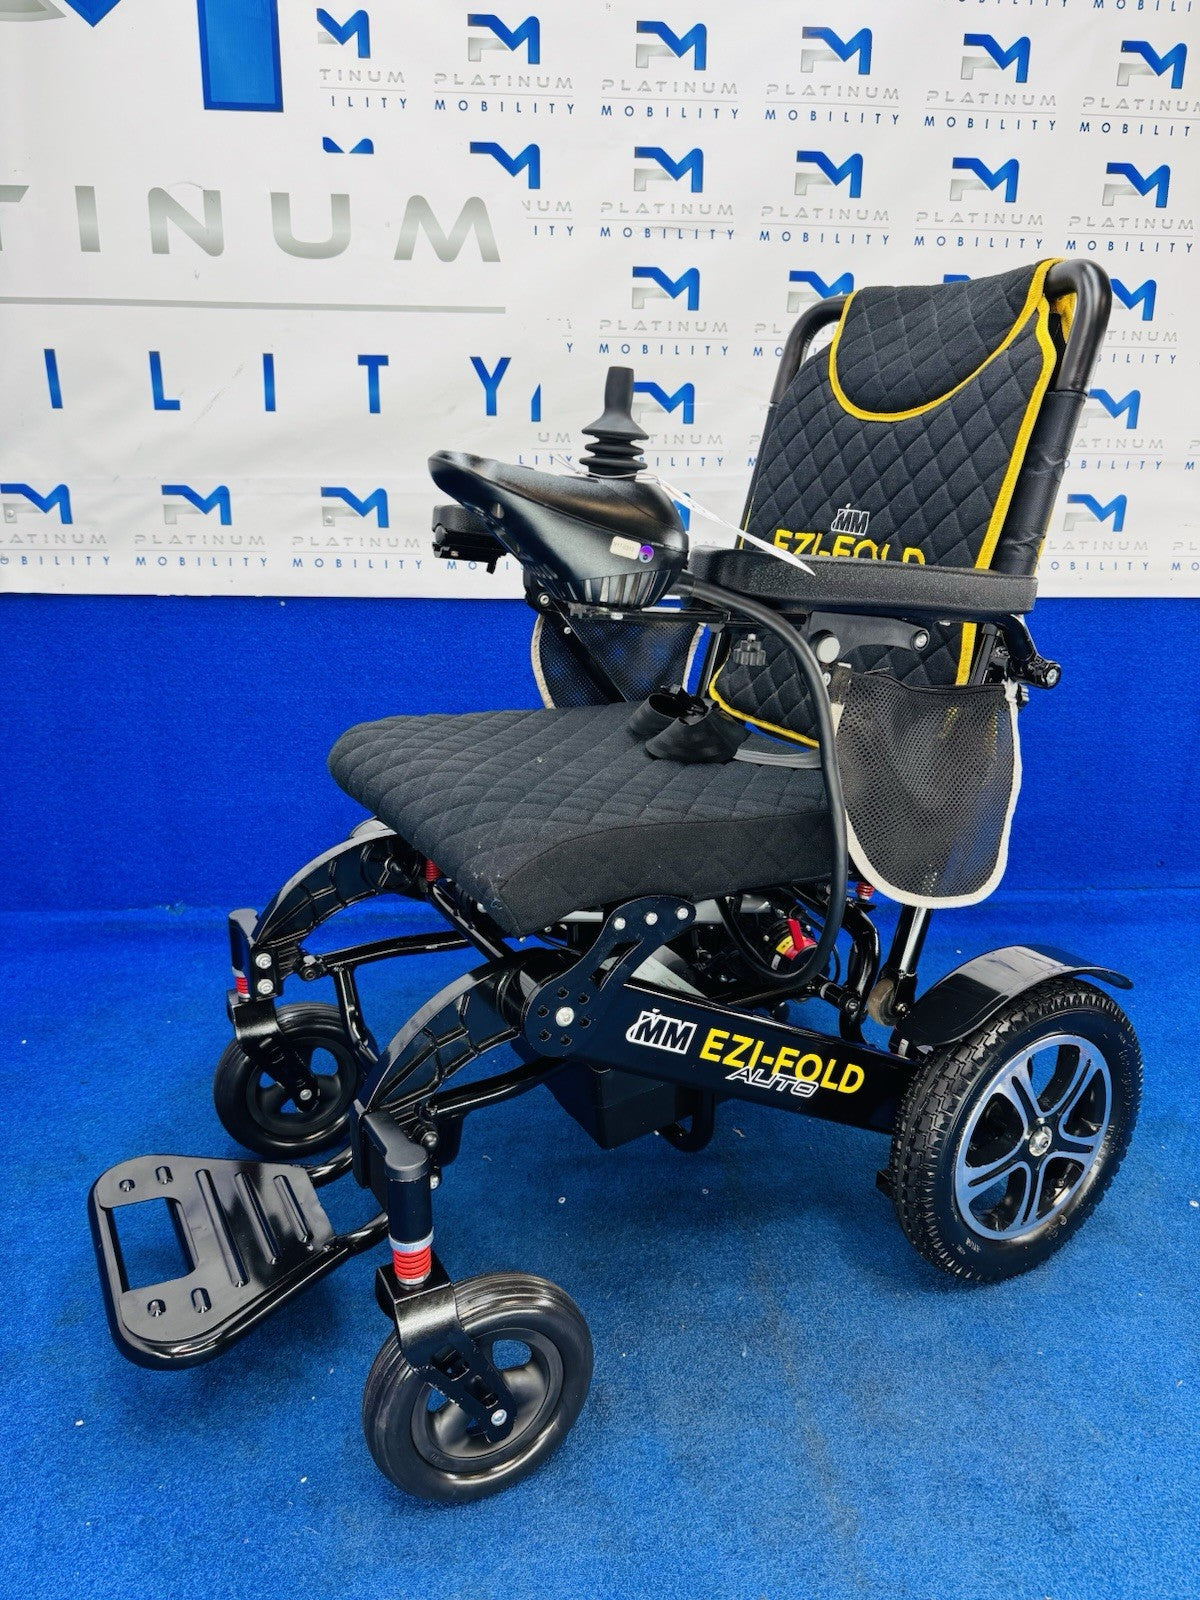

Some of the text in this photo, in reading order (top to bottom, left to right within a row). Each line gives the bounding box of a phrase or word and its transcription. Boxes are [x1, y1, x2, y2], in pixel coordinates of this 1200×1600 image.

[1093, 0, 1193, 13] MOBILI
[434, 73, 574, 90] PLATINUM
[601, 79, 739, 95] PLATINUM
[766, 84, 900, 100] PLATINUM
[926, 90, 1057, 106] PLATINUM
[434, 100, 575, 115] MOBILITY
[601, 105, 739, 119] MOBILITY
[765, 110, 900, 125] MOBILITY
[924, 116, 1056, 131] MOBILITY
[1080, 122, 1191, 137] MOBILIT
[600, 201, 734, 216] PLATINUM
[760, 206, 890, 221] PLATINUM
[916, 211, 1044, 226] PLATINUM
[1069, 216, 1195, 230] PLATINUM
[600, 226, 735, 240] MOBILITY
[759, 230, 890, 245] MOBILITY
[914, 235, 1043, 249] MOBILITY
[1066, 240, 1194, 253] MOBILITY
[599, 320, 728, 333] PLATINUM
[1106, 331, 1178, 342] TINUM
[598, 343, 729, 356] MOBILITY
[1112, 353, 1177, 364] ILITY
[649, 434, 723, 444] TINUM
[1075, 438, 1164, 449] ATINUM
[1064, 460, 1163, 470] OBILITY
[8, 533, 107, 544] ATINUM
[134, 535, 265, 546] PLATINUM
[293, 537, 420, 547] PLATINUM
[1049, 541, 1149, 551] LATINUM
[0, 555, 110, 566] OBILITY
[136, 556, 267, 567] MOBILITY
[292, 558, 422, 569] MOBILITY
[1051, 561, 1149, 571] OBILITY
[699, 1028, 865, 1094] EZI-FOLD
